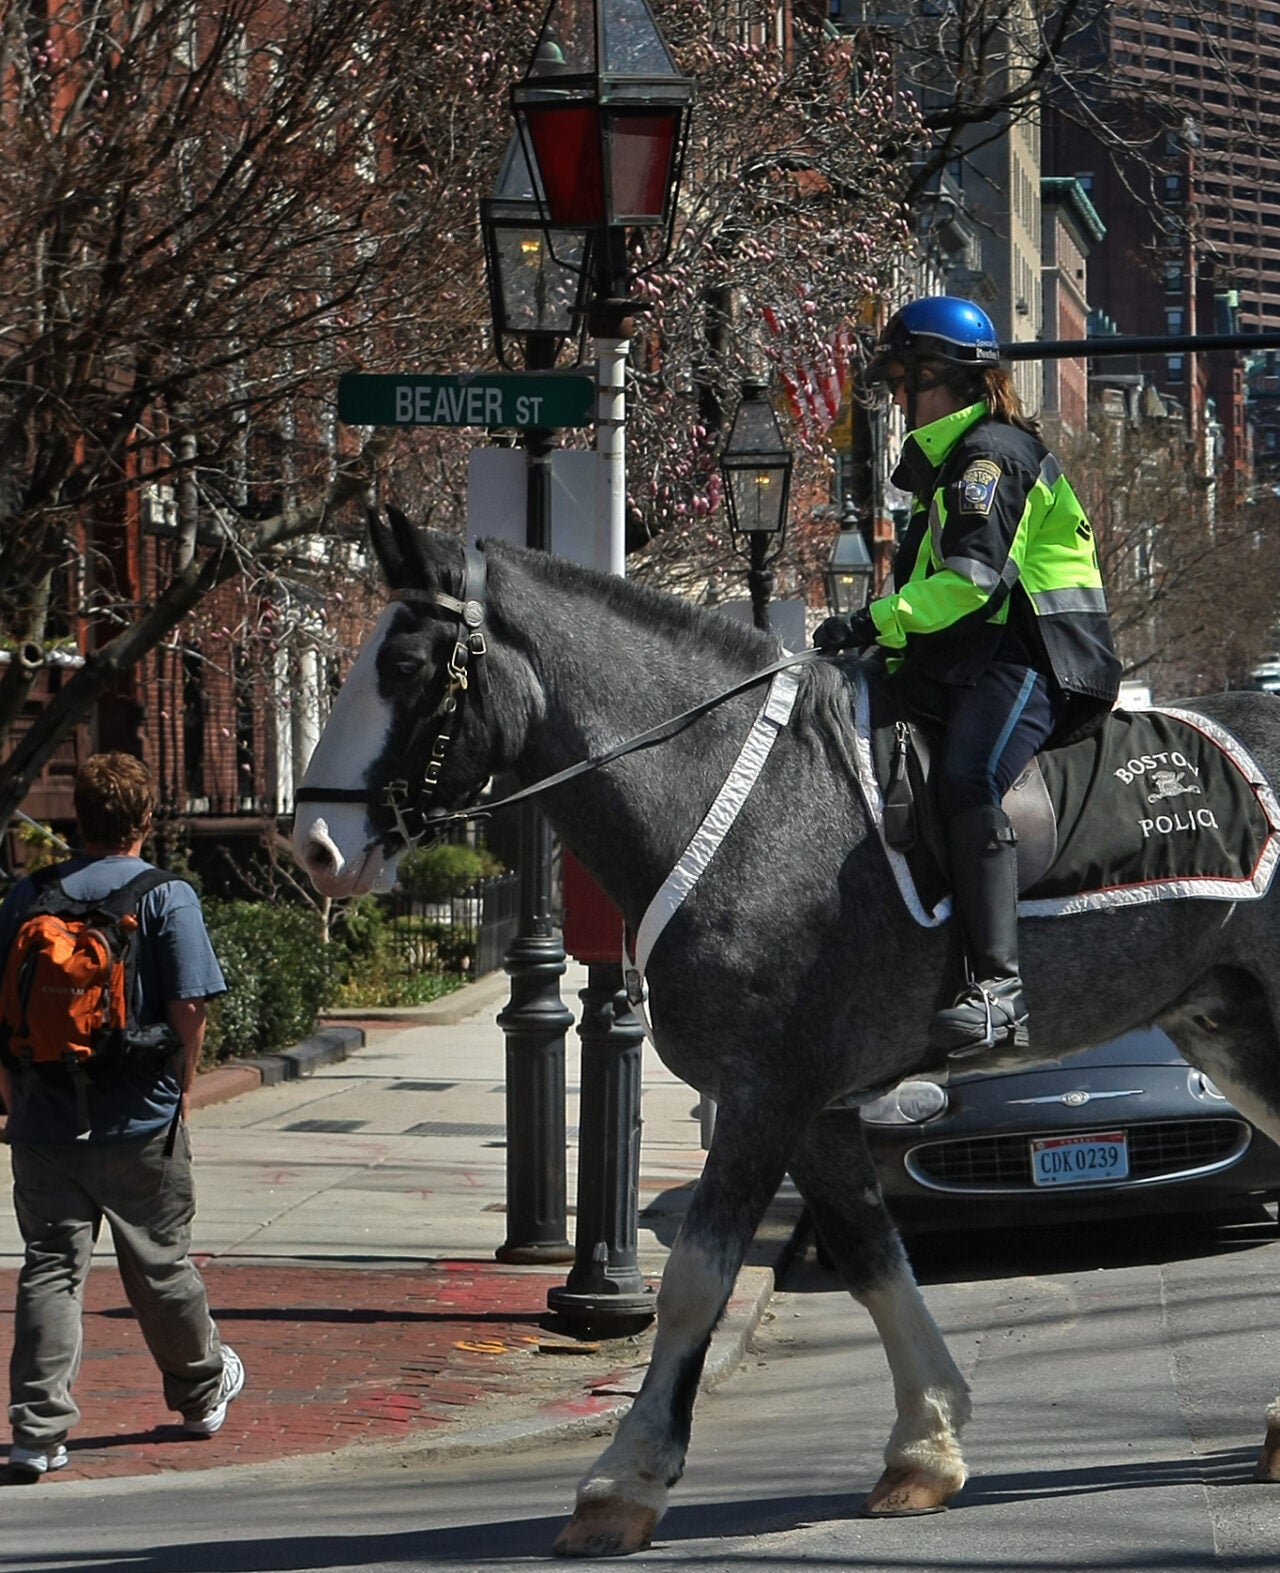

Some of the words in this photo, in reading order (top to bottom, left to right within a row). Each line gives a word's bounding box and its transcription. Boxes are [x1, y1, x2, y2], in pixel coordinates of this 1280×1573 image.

[395, 386, 503, 423] BEAVER
[515, 396, 543, 424] ST
[1041, 1150, 1073, 1173] CDK
[1075, 1146, 1118, 1170] 0239
